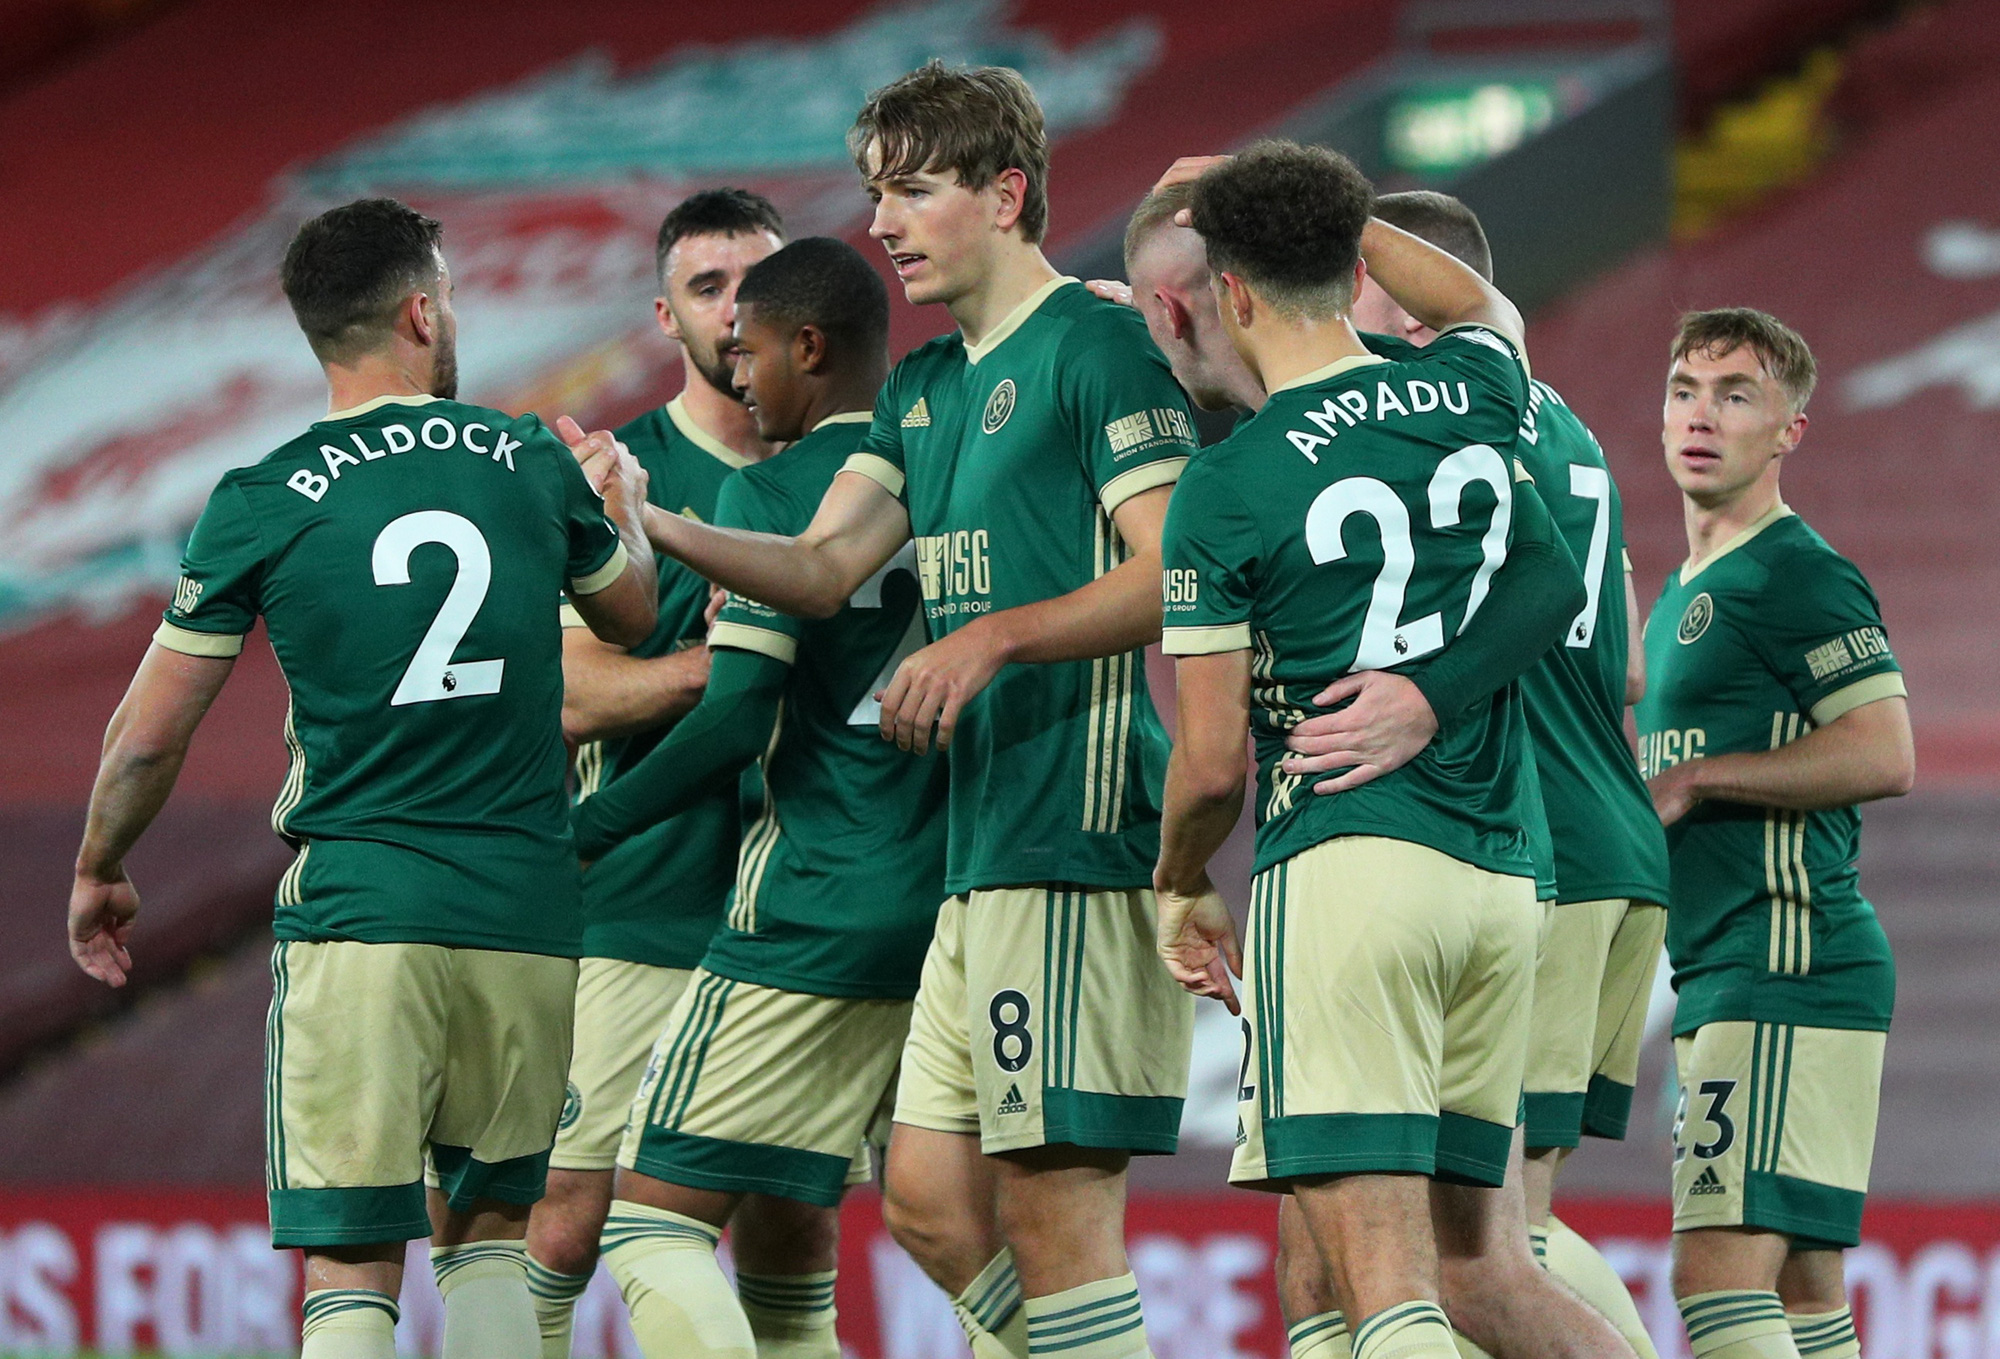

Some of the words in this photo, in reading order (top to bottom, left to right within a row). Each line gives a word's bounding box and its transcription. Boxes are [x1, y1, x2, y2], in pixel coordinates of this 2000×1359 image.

[1152, 408, 1193, 440] USG
[1284, 379, 1472, 466] AMPADU
[285, 416, 523, 503] BALDOCK
[1113, 447, 1137, 461] UNION
[943, 528, 991, 597] USG
[1304, 443, 1514, 674] 22
[1564, 463, 1610, 649] 7
[173, 575, 204, 614] USG
[1163, 568, 1198, 603] USG
[371, 509, 506, 707] 2
[1172, 604, 1197, 612] GROUP
[1847, 626, 1890, 660] USG
[988, 989, 1033, 1073] 8
[997, 1103, 1028, 1116] adidas
[1690, 1184, 1726, 1195] adidas
